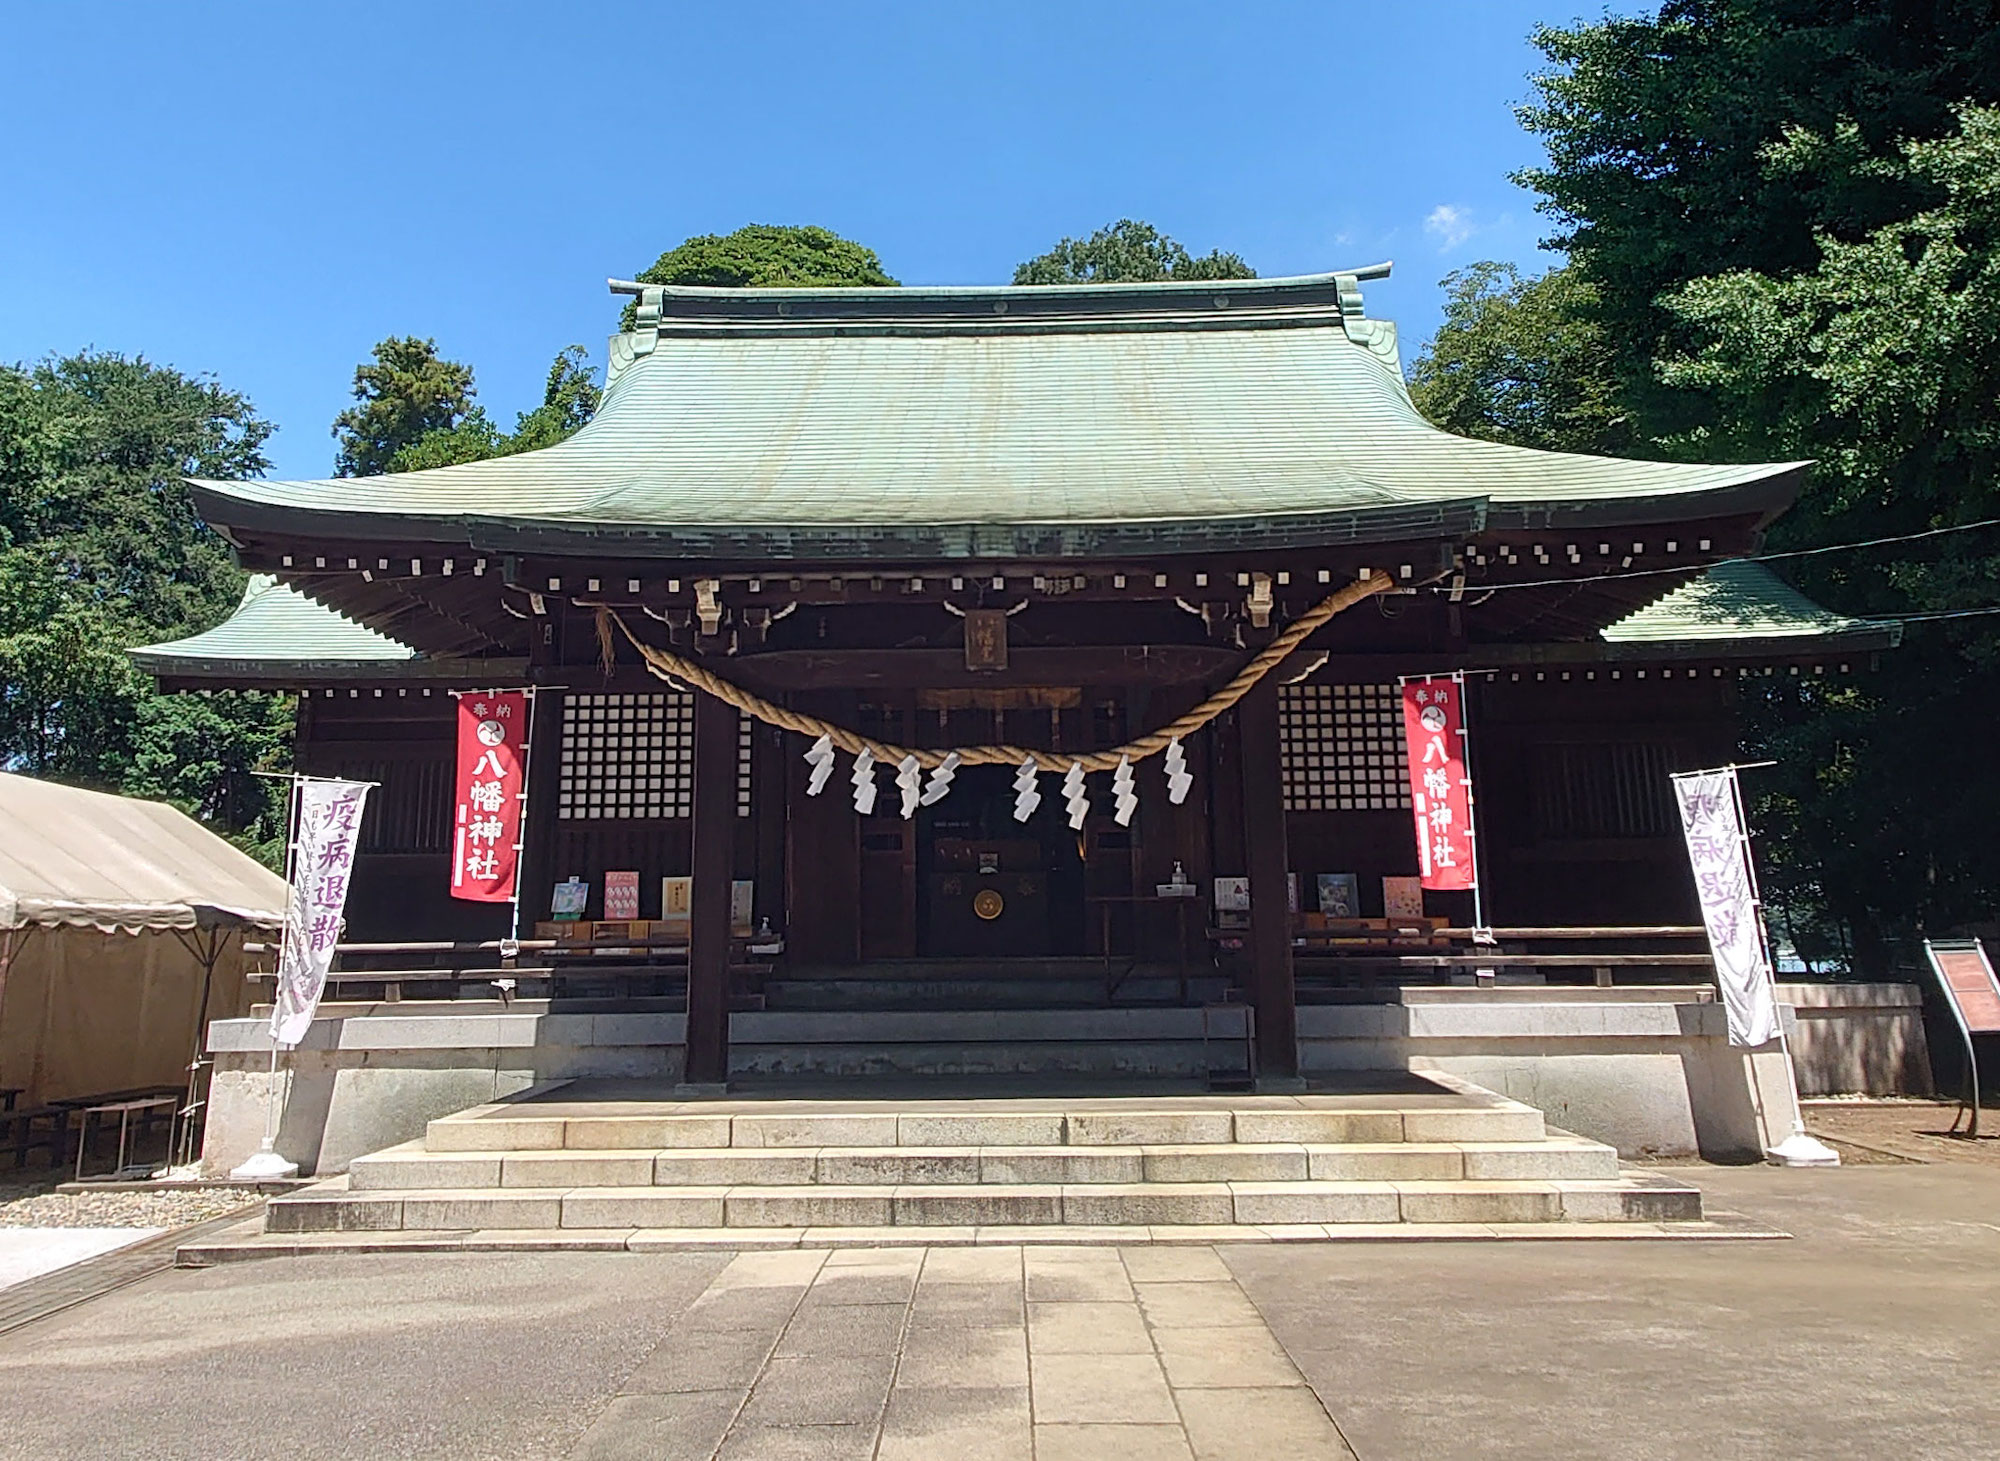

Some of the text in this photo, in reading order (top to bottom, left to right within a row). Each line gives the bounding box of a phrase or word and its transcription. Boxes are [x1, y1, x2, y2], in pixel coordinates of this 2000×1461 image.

[473, 702, 511, 718] 奉納
[1415, 688, 1449, 705] 奉納
[466, 750, 508, 880] 八幡神社
[1421, 735, 1457, 868] 八幡神社
[308, 794, 357, 952] 疫病退散
